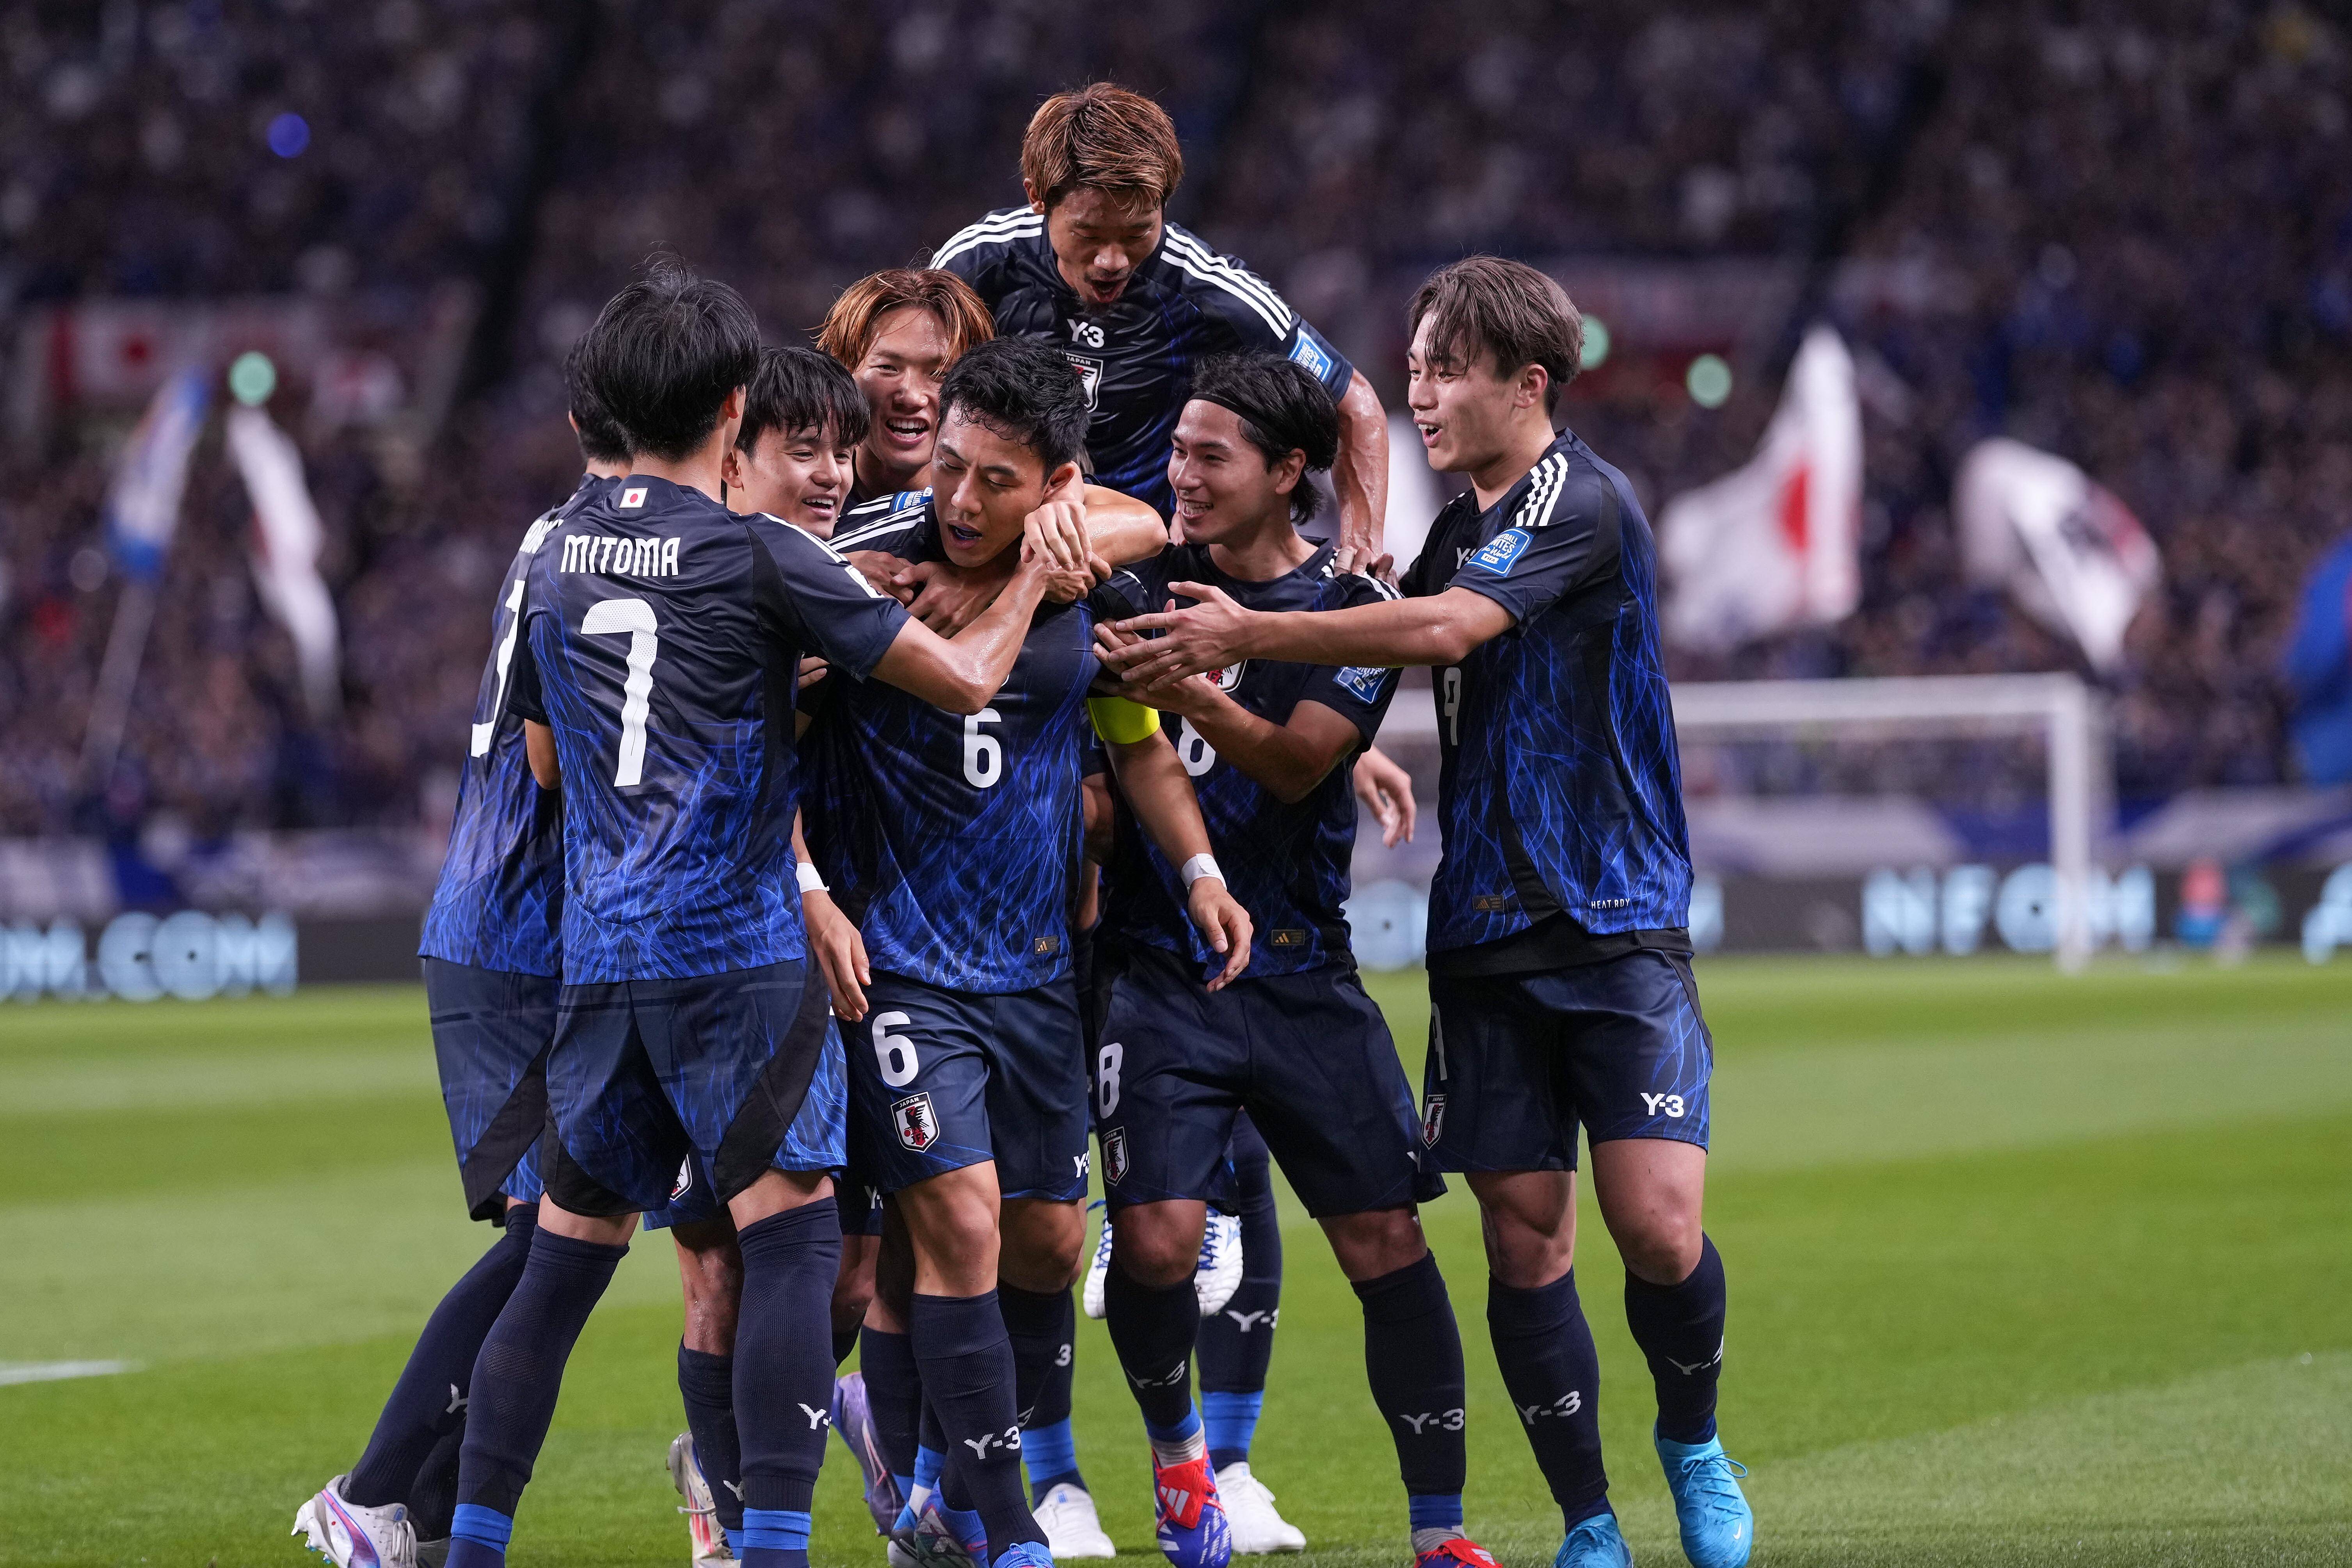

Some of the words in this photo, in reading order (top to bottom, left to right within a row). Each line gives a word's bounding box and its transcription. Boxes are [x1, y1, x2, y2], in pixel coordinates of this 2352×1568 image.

[1067, 318, 1105, 348] Y-3
[1067, 356, 1091, 365] JAPAN
[560, 535, 681, 577] MITOMA
[1490, 546, 1512, 560] World
[1492, 539, 1515, 553] NITES
[581, 599, 658, 787] 7
[1444, 667, 1461, 746] 9
[964, 708, 1002, 788] 6
[1591, 898, 1630, 909] HEAT.RDY
[0, 909, 299, 1004] M.COM
[872, 1011, 919, 1087] 6
[1099, 1042, 1123, 1119] 8
[900, 1097, 919, 1108] JAPAN
[1640, 1092, 1684, 1118] Y-3
[911, 1132, 929, 1145] JFA
[864, 1186, 884, 1209] Y-
[1665, 1334, 1724, 1375] Y-3
[1126, 1360, 1185, 1389] Y-3
[797, 1403, 832, 1438] Y-
[1399, 1408, 1464, 1435] Y-3
[1516, 1390, 1581, 1425] Y-3
[964, 1426, 1021, 1460] Y-3
